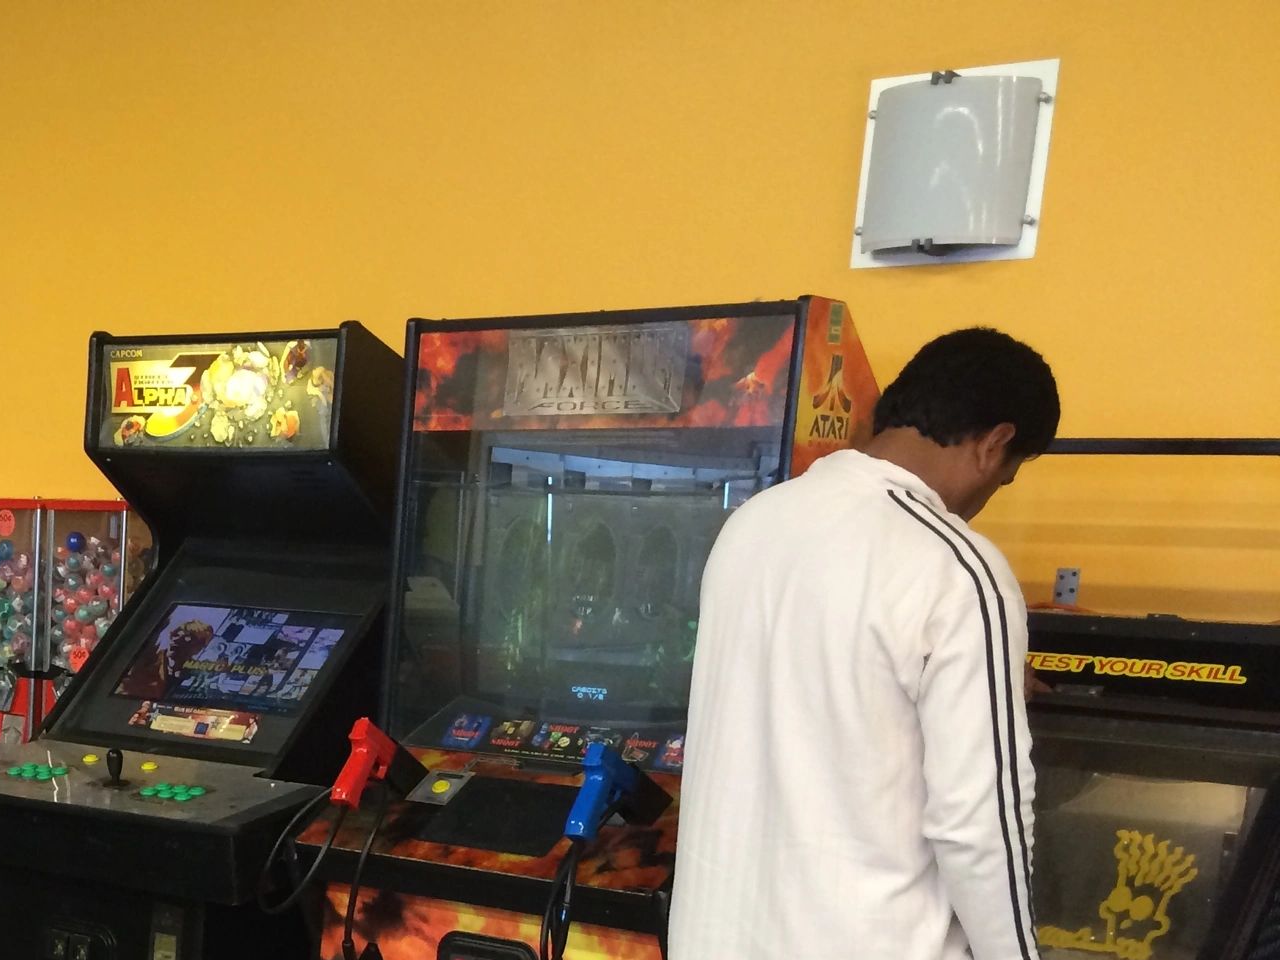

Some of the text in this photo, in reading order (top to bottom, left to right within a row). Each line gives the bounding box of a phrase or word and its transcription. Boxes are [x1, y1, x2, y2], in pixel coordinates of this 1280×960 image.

[111, 349, 143, 358] CAPCOM
[114, 367, 187, 407] ALPHA
[528, 400, 653, 411] FORCE
[809, 414, 850, 440] ATARI
[1027, 652, 1247, 684] TEST YOUR SKILL
